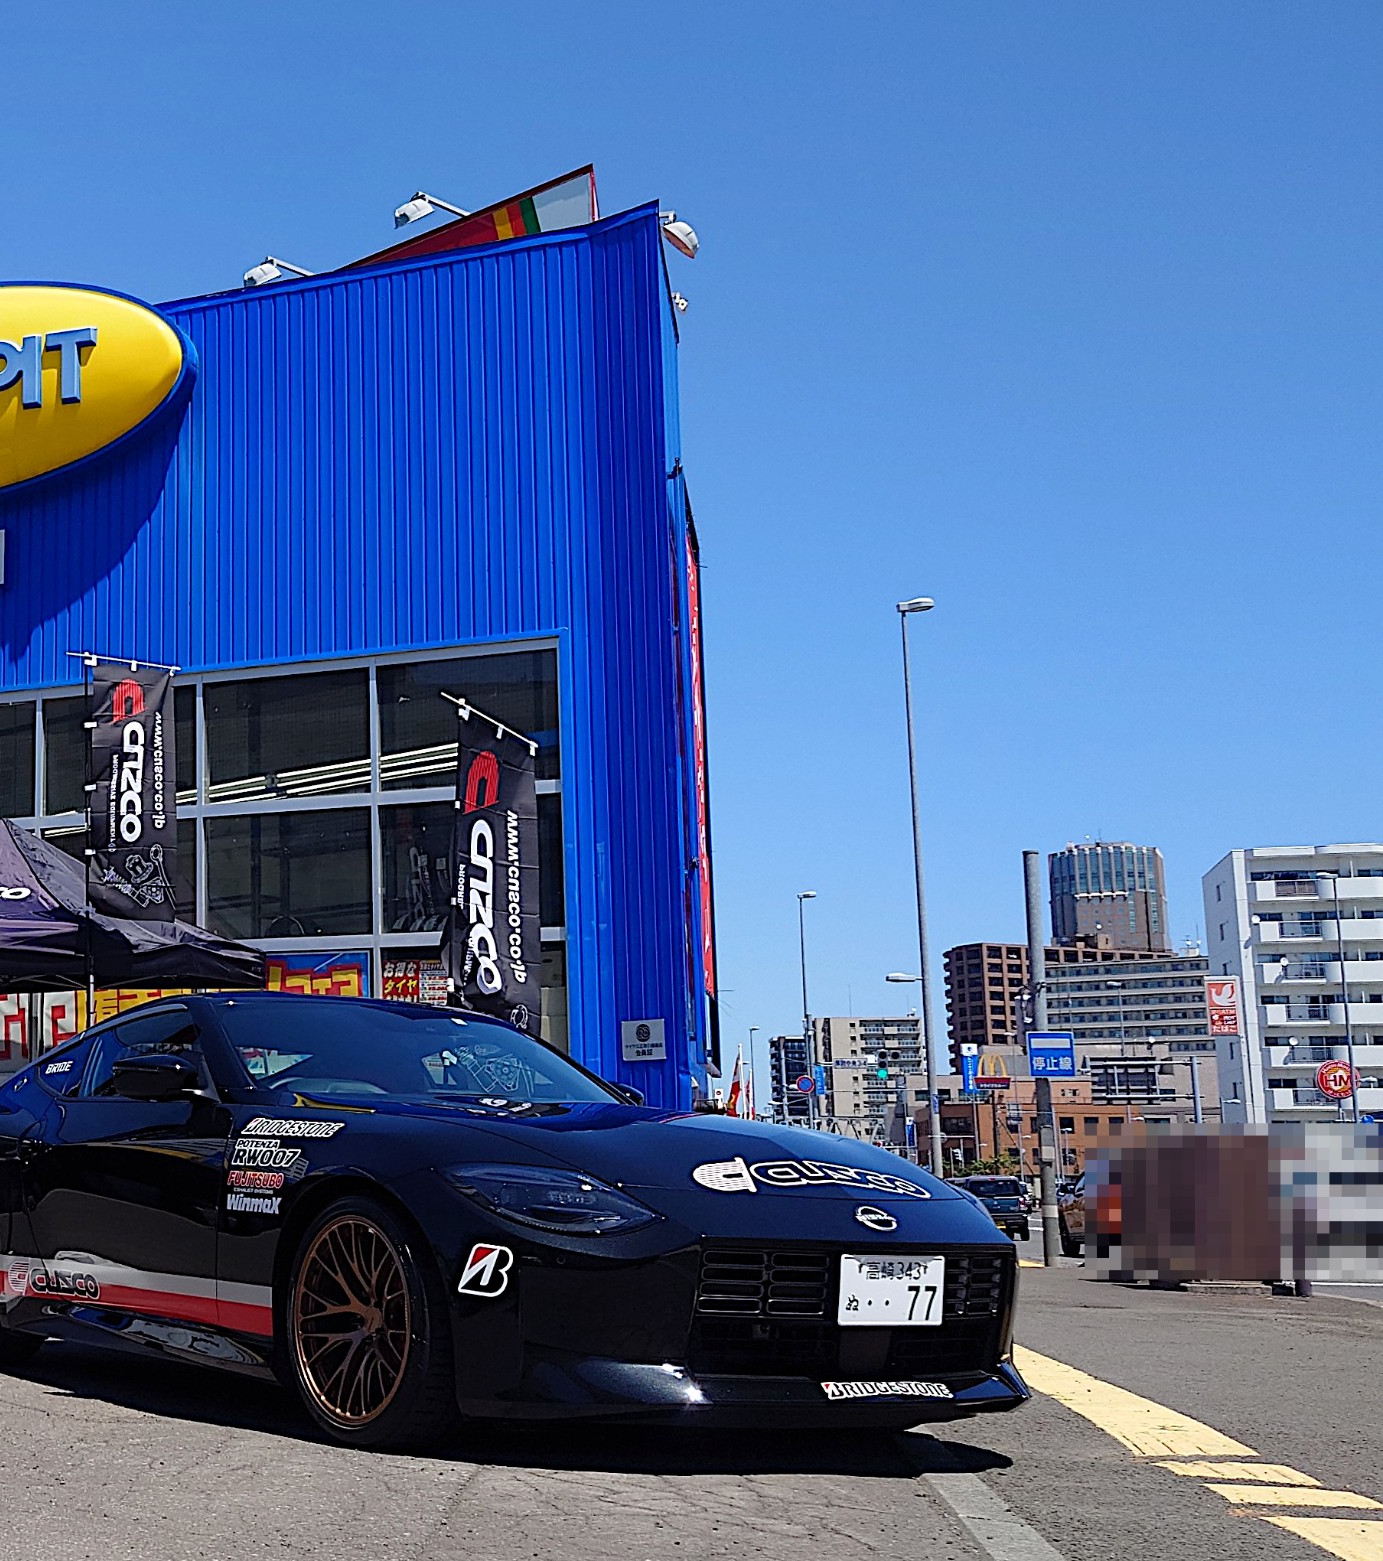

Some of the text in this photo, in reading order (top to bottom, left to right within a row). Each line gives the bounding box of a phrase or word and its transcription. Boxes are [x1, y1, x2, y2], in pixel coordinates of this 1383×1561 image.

[384, 979, 418, 994] タイヤ
[45, 1060, 74, 1075] BRIDE
[1032, 1056, 1073, 1071] 停止線
[241, 1117, 345, 1138] BRIDGESTONE
[235, 1139, 281, 1150] POTENZA
[231, 1148, 301, 1168] RW007
[227, 1170, 285, 1189] FUJITSUBO
[29, 1266, 101, 1300] CUSCO
[820, 1380, 955, 1401] BRIDGESTONE
